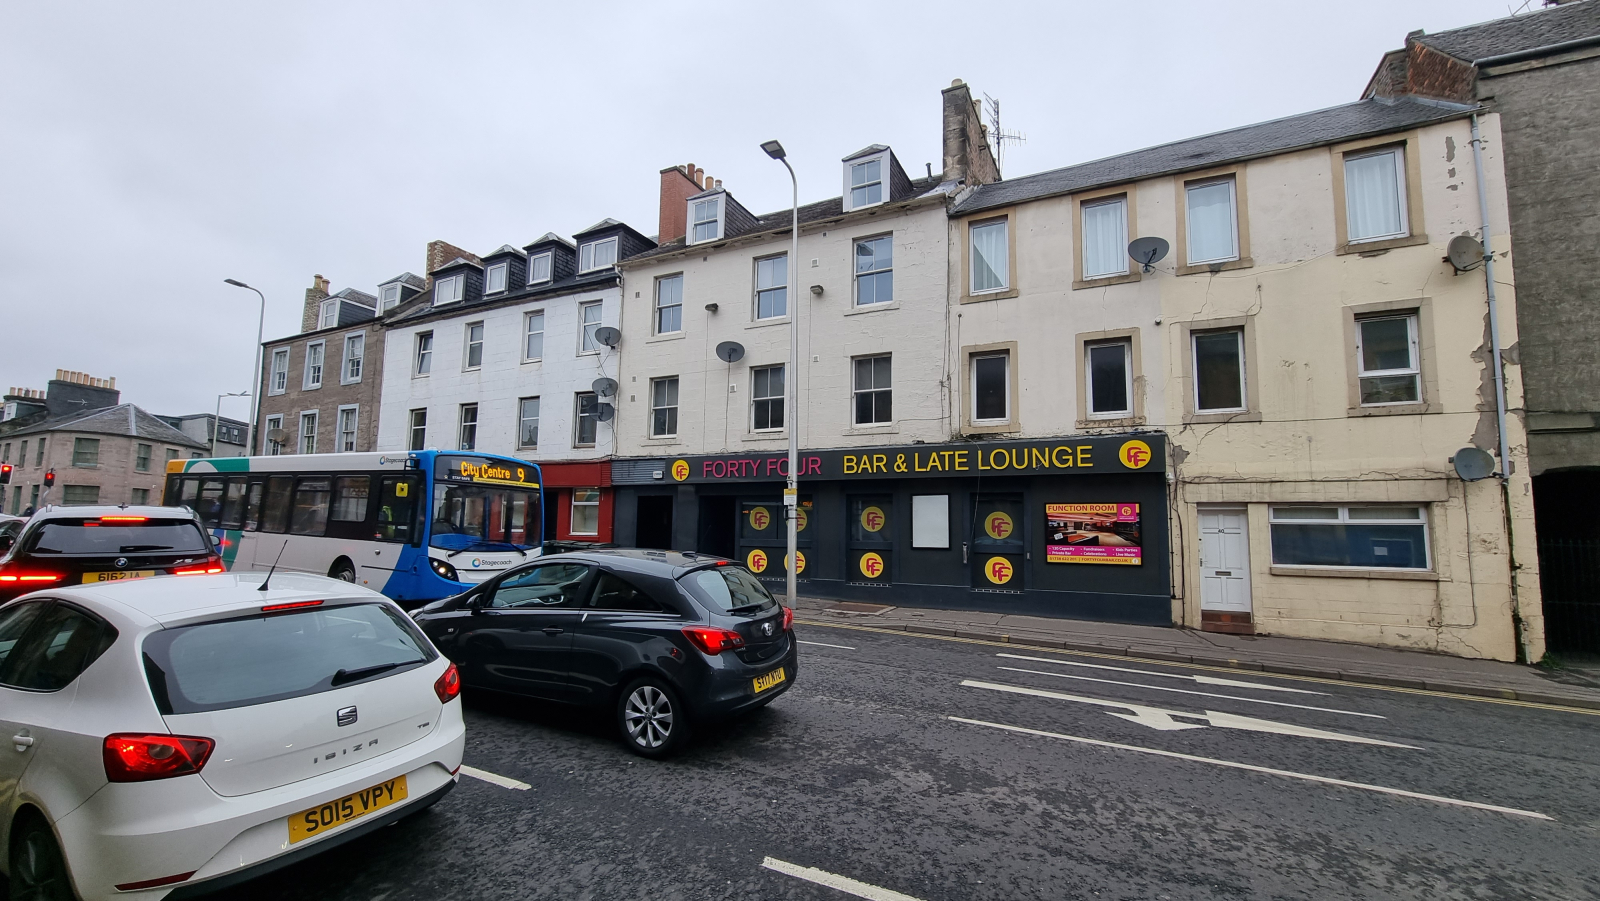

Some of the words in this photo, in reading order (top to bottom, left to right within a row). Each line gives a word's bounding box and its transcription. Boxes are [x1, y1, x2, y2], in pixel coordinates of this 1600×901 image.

[461, 461, 479, 478] City
[481, 464, 511, 479] Centre
[517, 467, 525, 482] 9
[703, 459, 761, 478] FORTY
[766, 456, 822, 477] FOUR
[843, 454, 887, 474] BAR
[894, 453, 908, 473] &
[914, 451, 969, 472] LATE
[977, 445, 1094, 471] LOUNGE
[1047, 504, 1088, 512] FUNCTION
[1089, 504, 1115, 512] ROOM
[481, 559, 512, 567] Stagecoach
[313, 738, 379, 764] IBIZA
[304, 797, 354, 833] SO15
[358, 780, 395, 811] VPY
